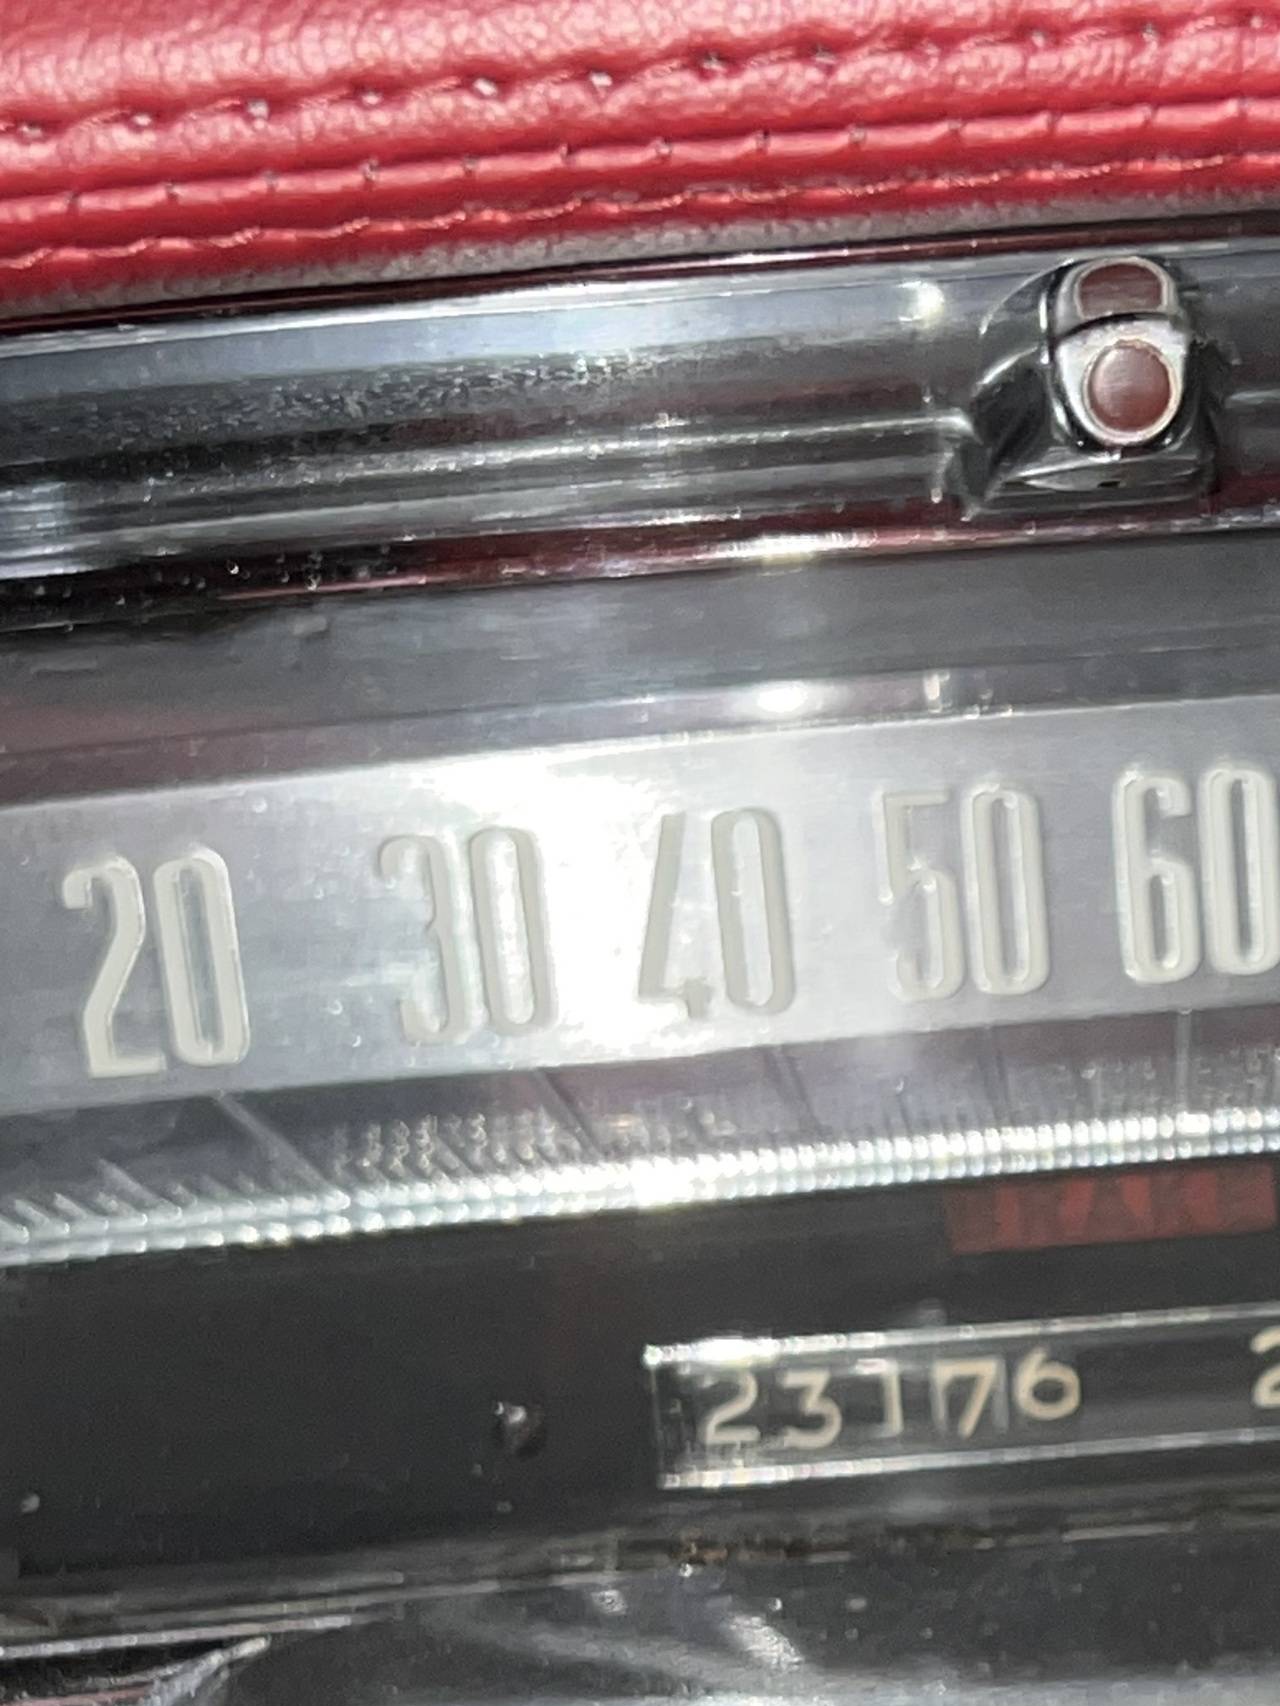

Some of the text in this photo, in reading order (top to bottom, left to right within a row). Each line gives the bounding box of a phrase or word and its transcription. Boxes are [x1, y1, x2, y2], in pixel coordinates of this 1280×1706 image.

[62, 845, 251, 1078] 20
[375, 826, 558, 1043] 30
[637, 808, 797, 1020] 40
[872, 780, 1051, 1002] 50
[701, 1346, 1082, 1449] 23176
